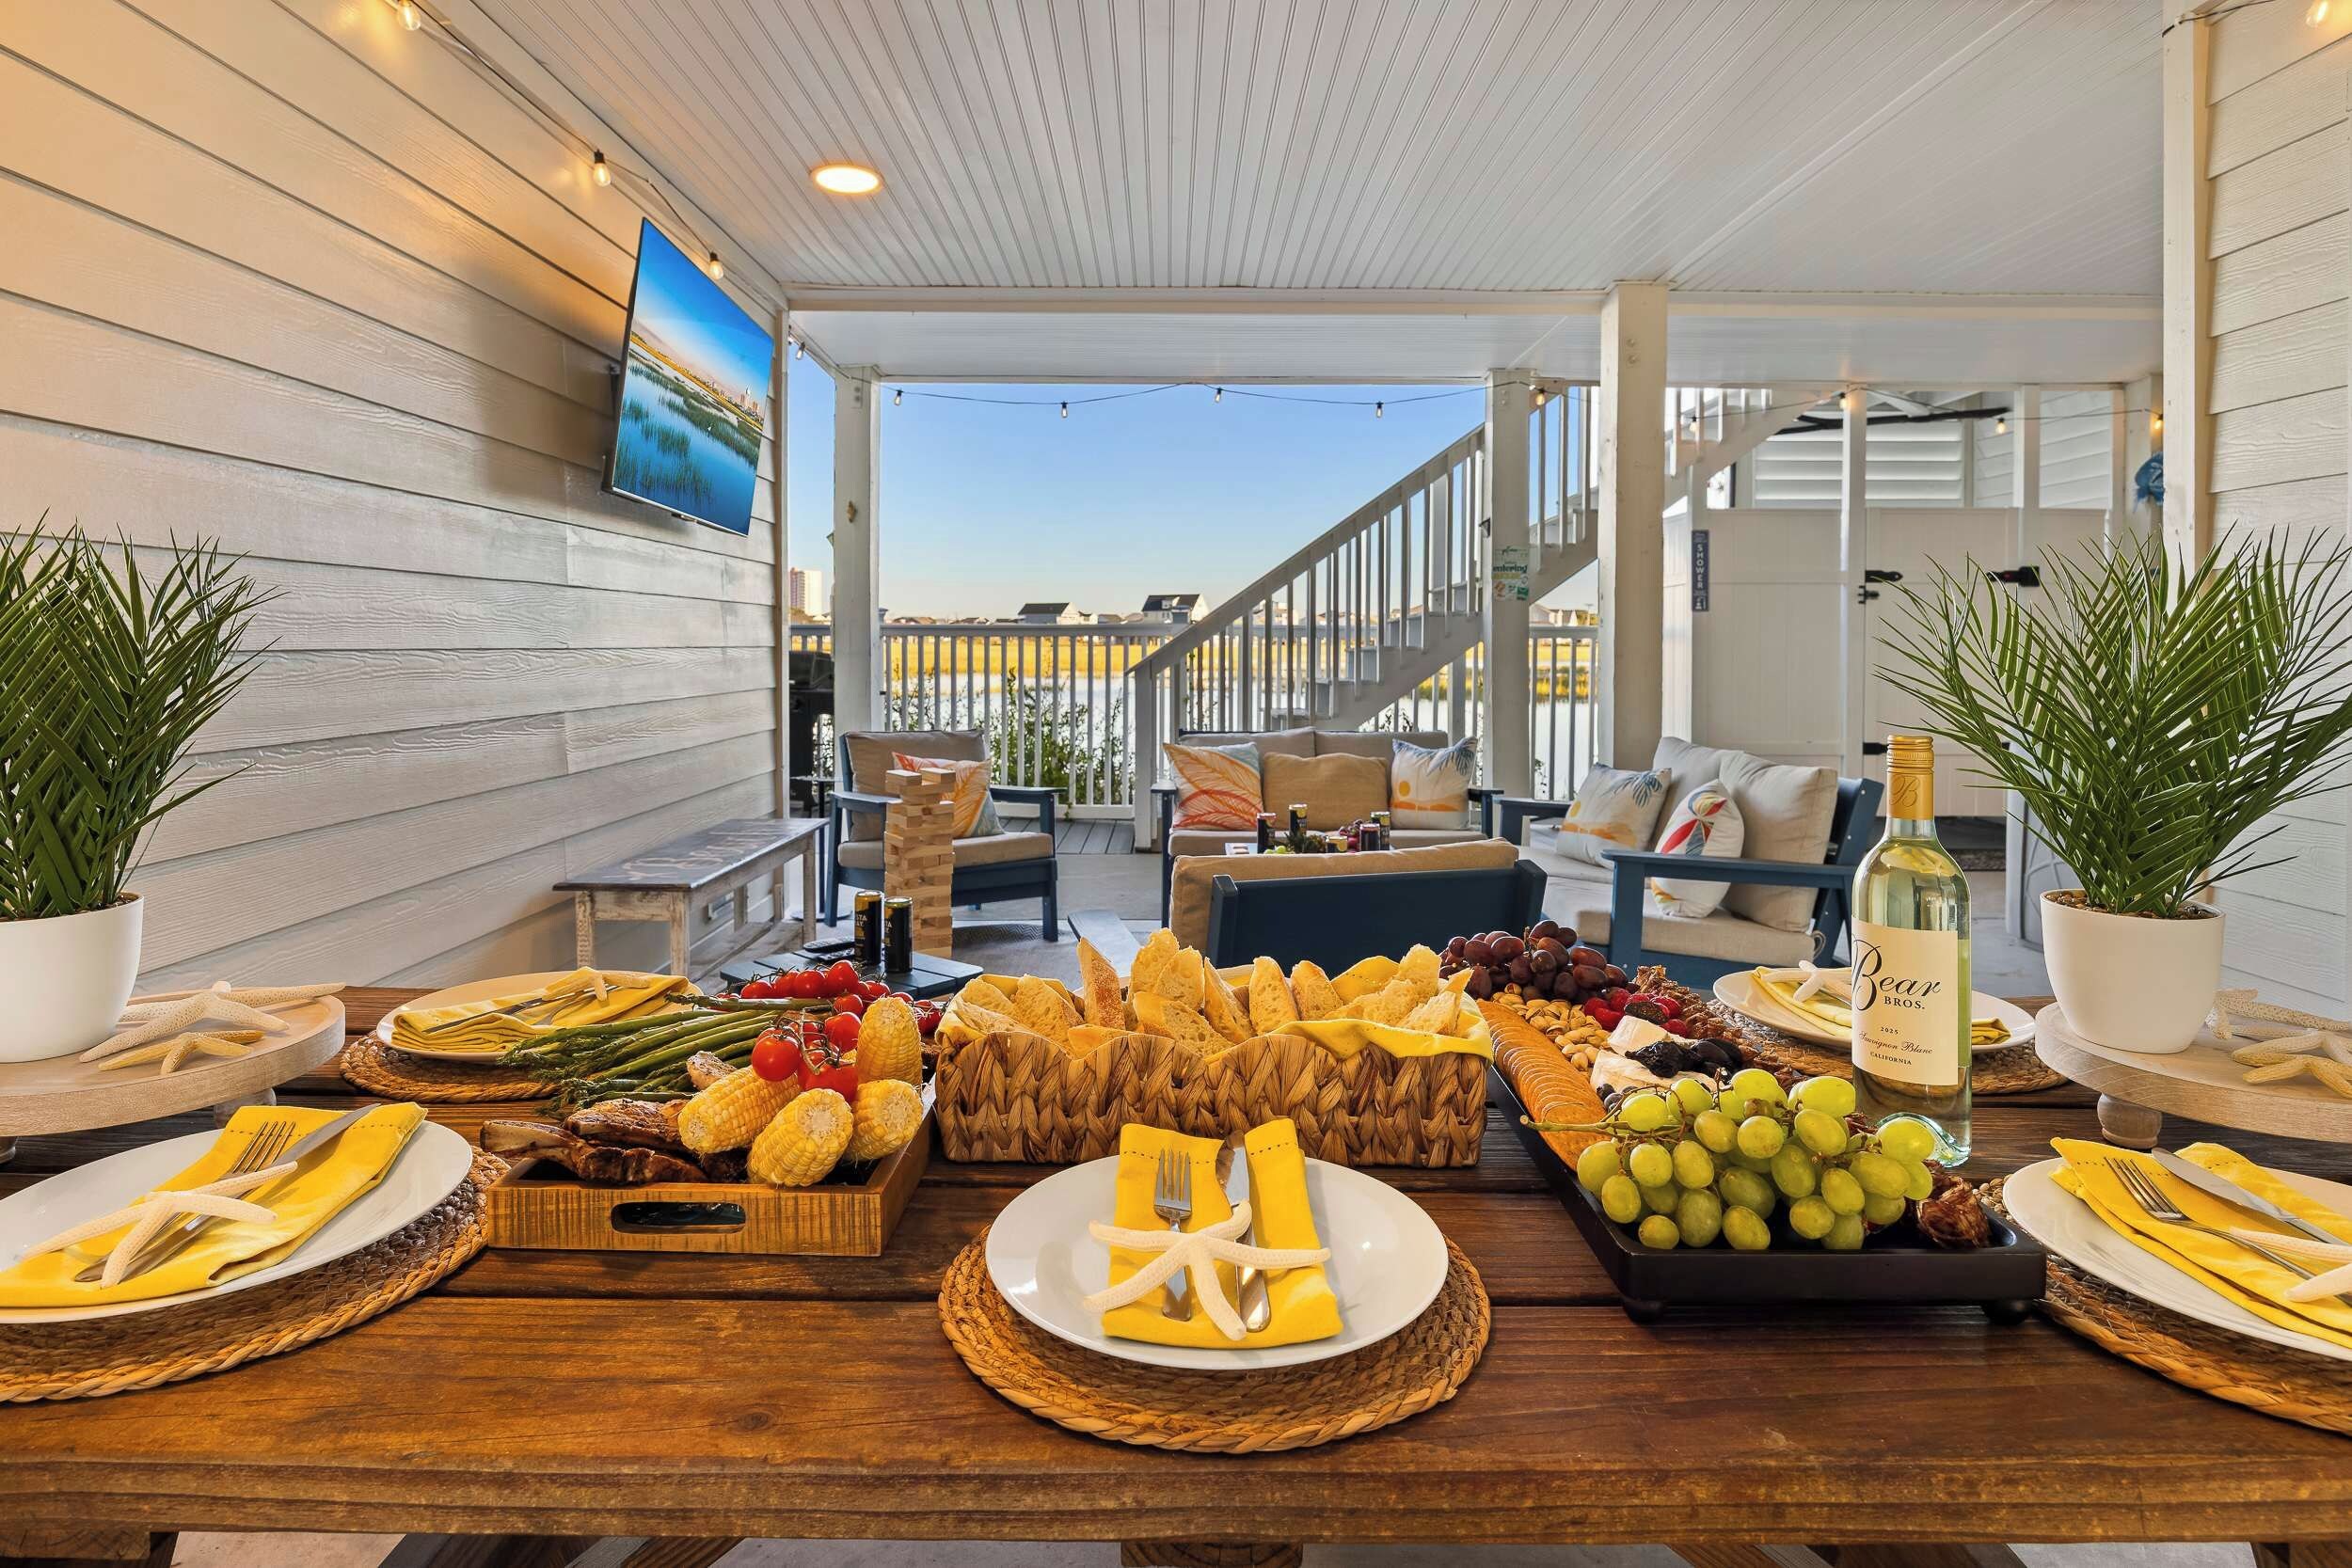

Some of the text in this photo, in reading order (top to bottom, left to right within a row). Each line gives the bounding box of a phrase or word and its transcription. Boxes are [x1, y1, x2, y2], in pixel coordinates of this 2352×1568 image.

[1695, 544, 1705, 589] SHOWER
[1851, 938, 1941, 1011] Bear
[1884, 995, 1925, 1009] BROS.
[1858, 1031, 1932, 1054] Sauvignon Blanc
[1870, 1052, 1912, 1065] CALIFORNIA
